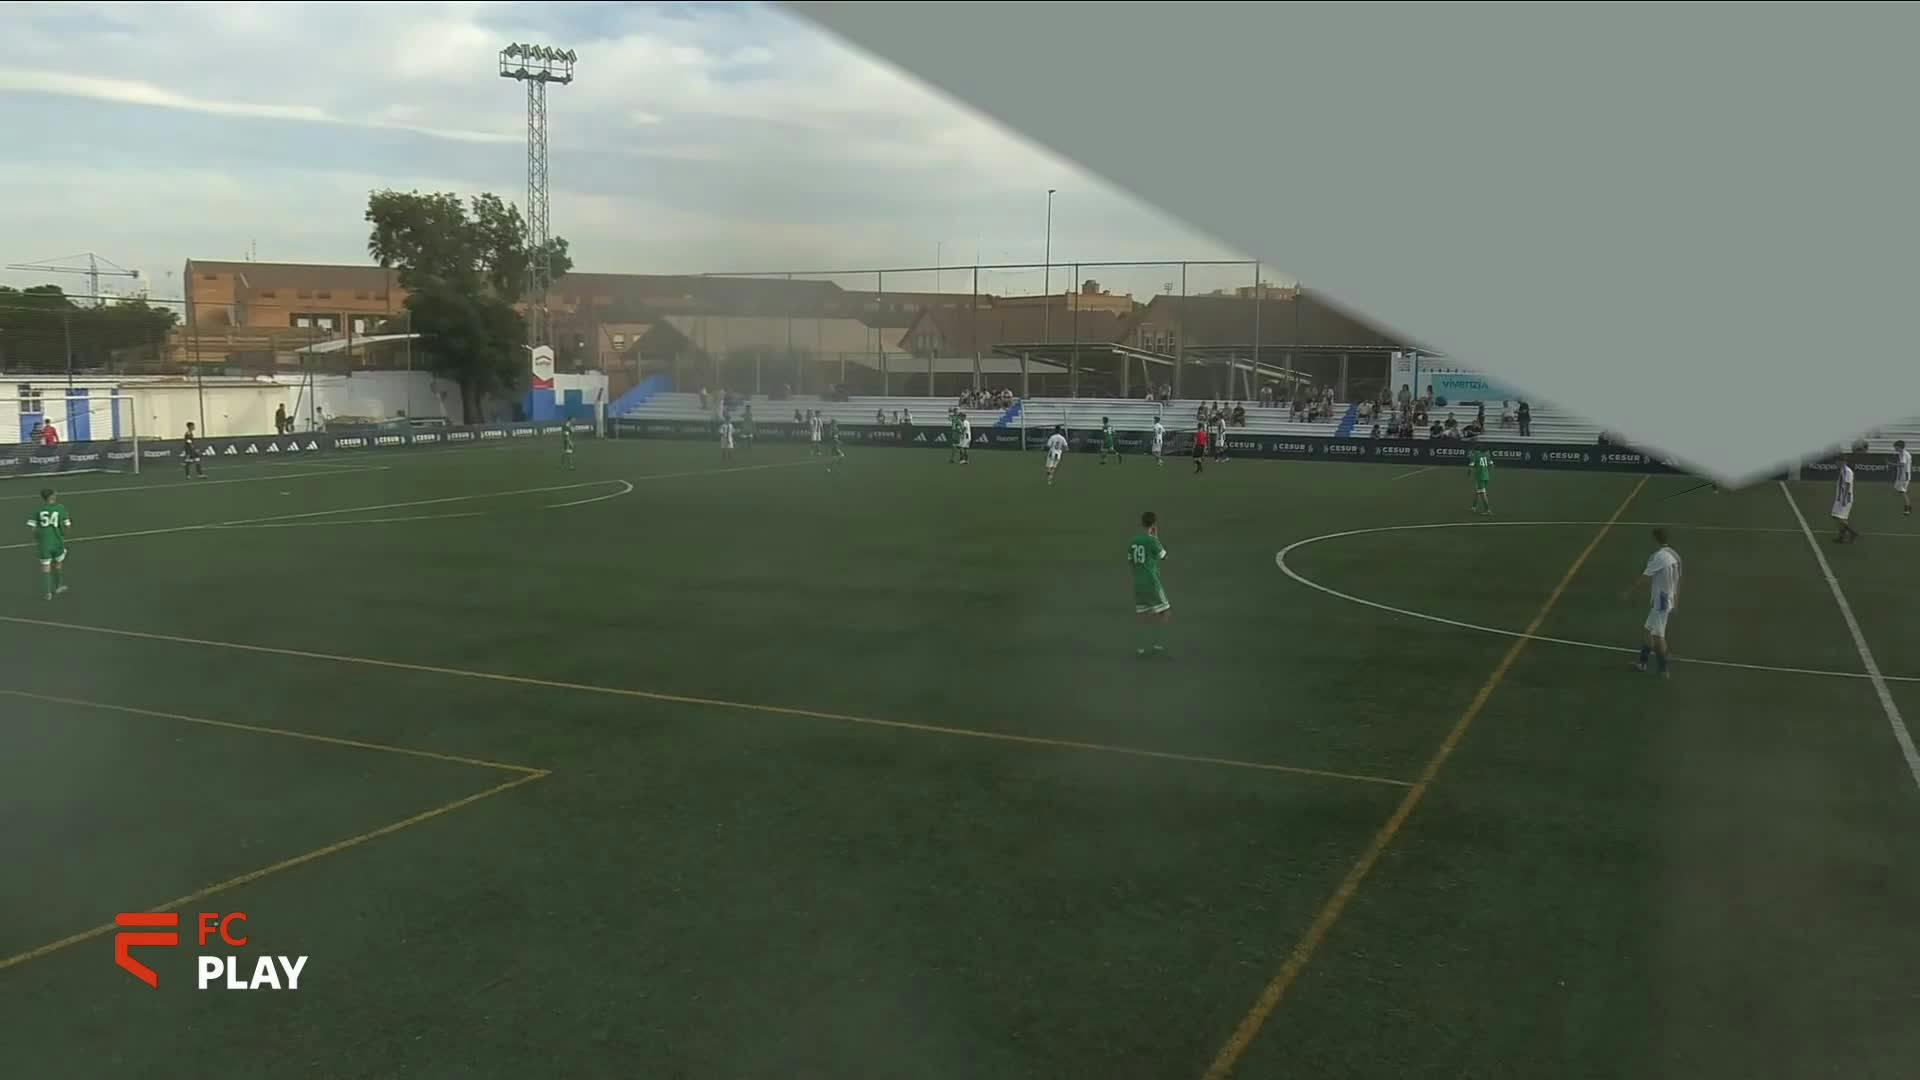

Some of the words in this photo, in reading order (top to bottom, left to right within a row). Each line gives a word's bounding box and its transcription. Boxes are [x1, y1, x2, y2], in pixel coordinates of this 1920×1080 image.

[1382, 446, 1411, 454] CESUR
[39, 511, 59, 528] 54
[1131, 544, 1145, 564] 79
